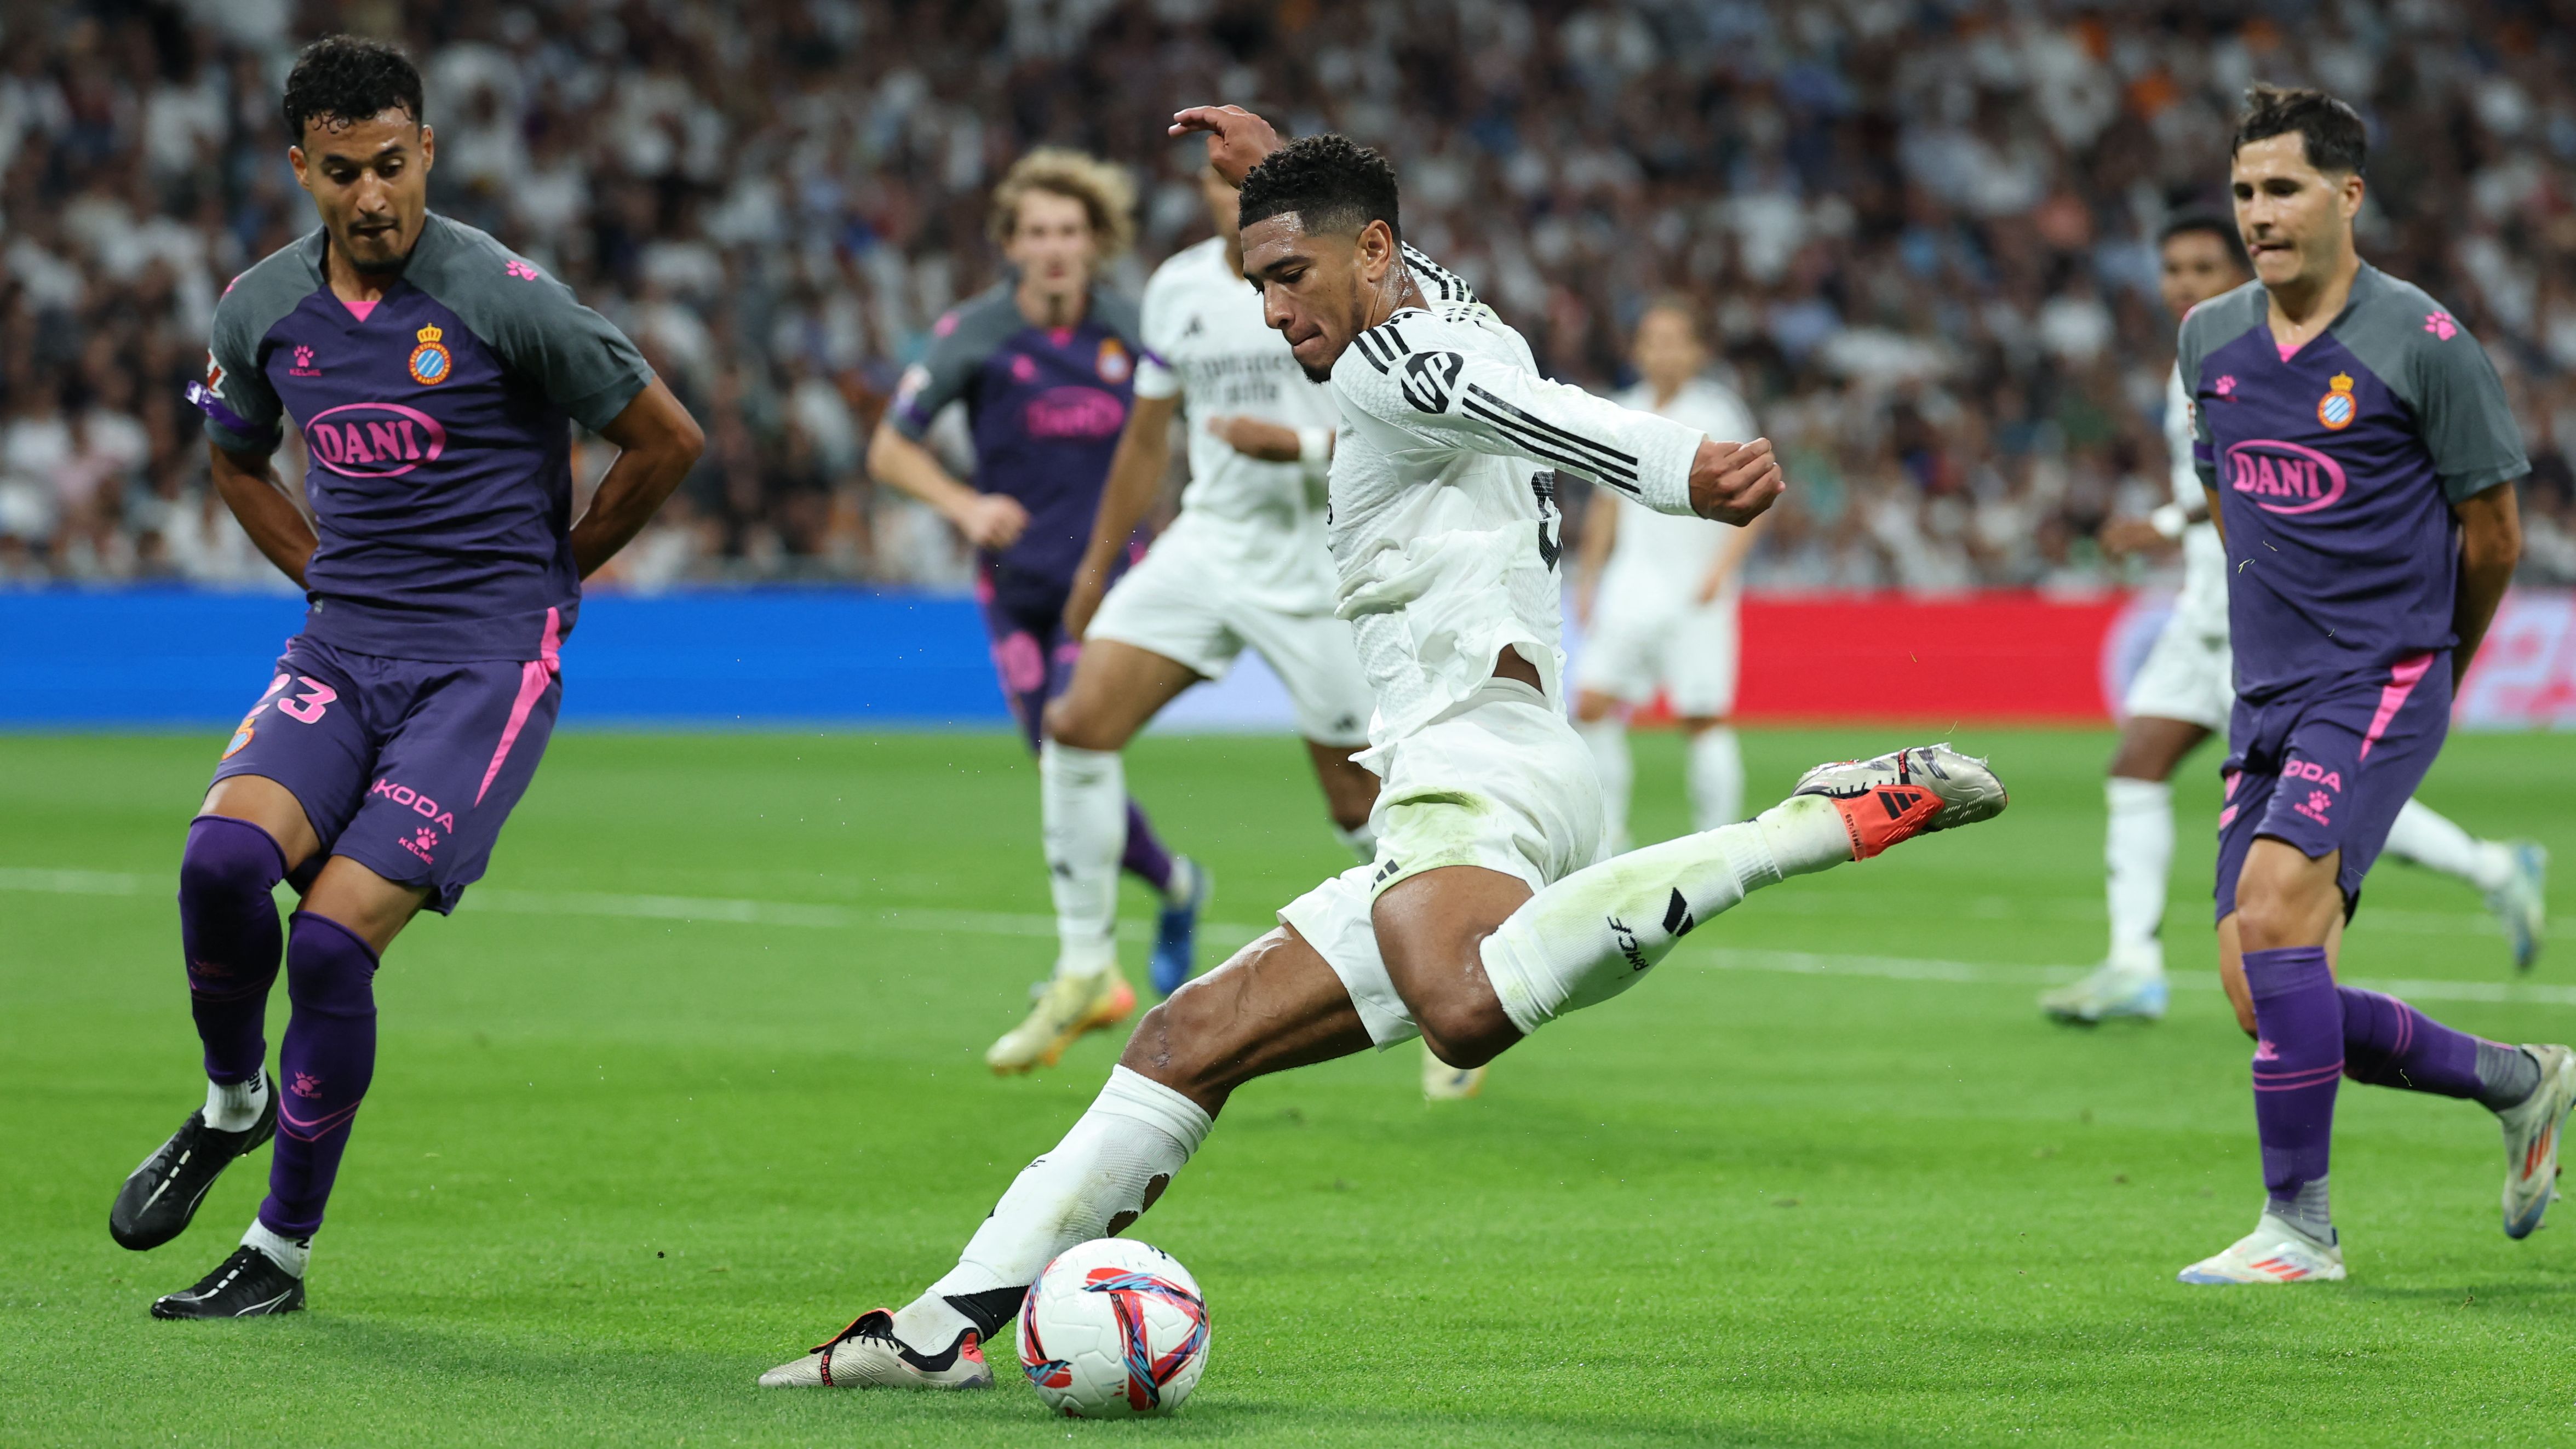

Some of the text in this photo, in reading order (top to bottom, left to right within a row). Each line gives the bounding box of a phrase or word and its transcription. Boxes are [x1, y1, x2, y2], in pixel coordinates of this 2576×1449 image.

[313, 420, 421, 464] DANI
[2231, 451, 2322, 499] DANI
[2282, 760, 2342, 793] ODA
[366, 778, 454, 834] KODA
[1845, 814, 1854, 829] EST.
[398, 837, 434, 865] KELME
[1607, 916, 1649, 971] RMCF
[822, 1354, 832, 1386] EDATOR
